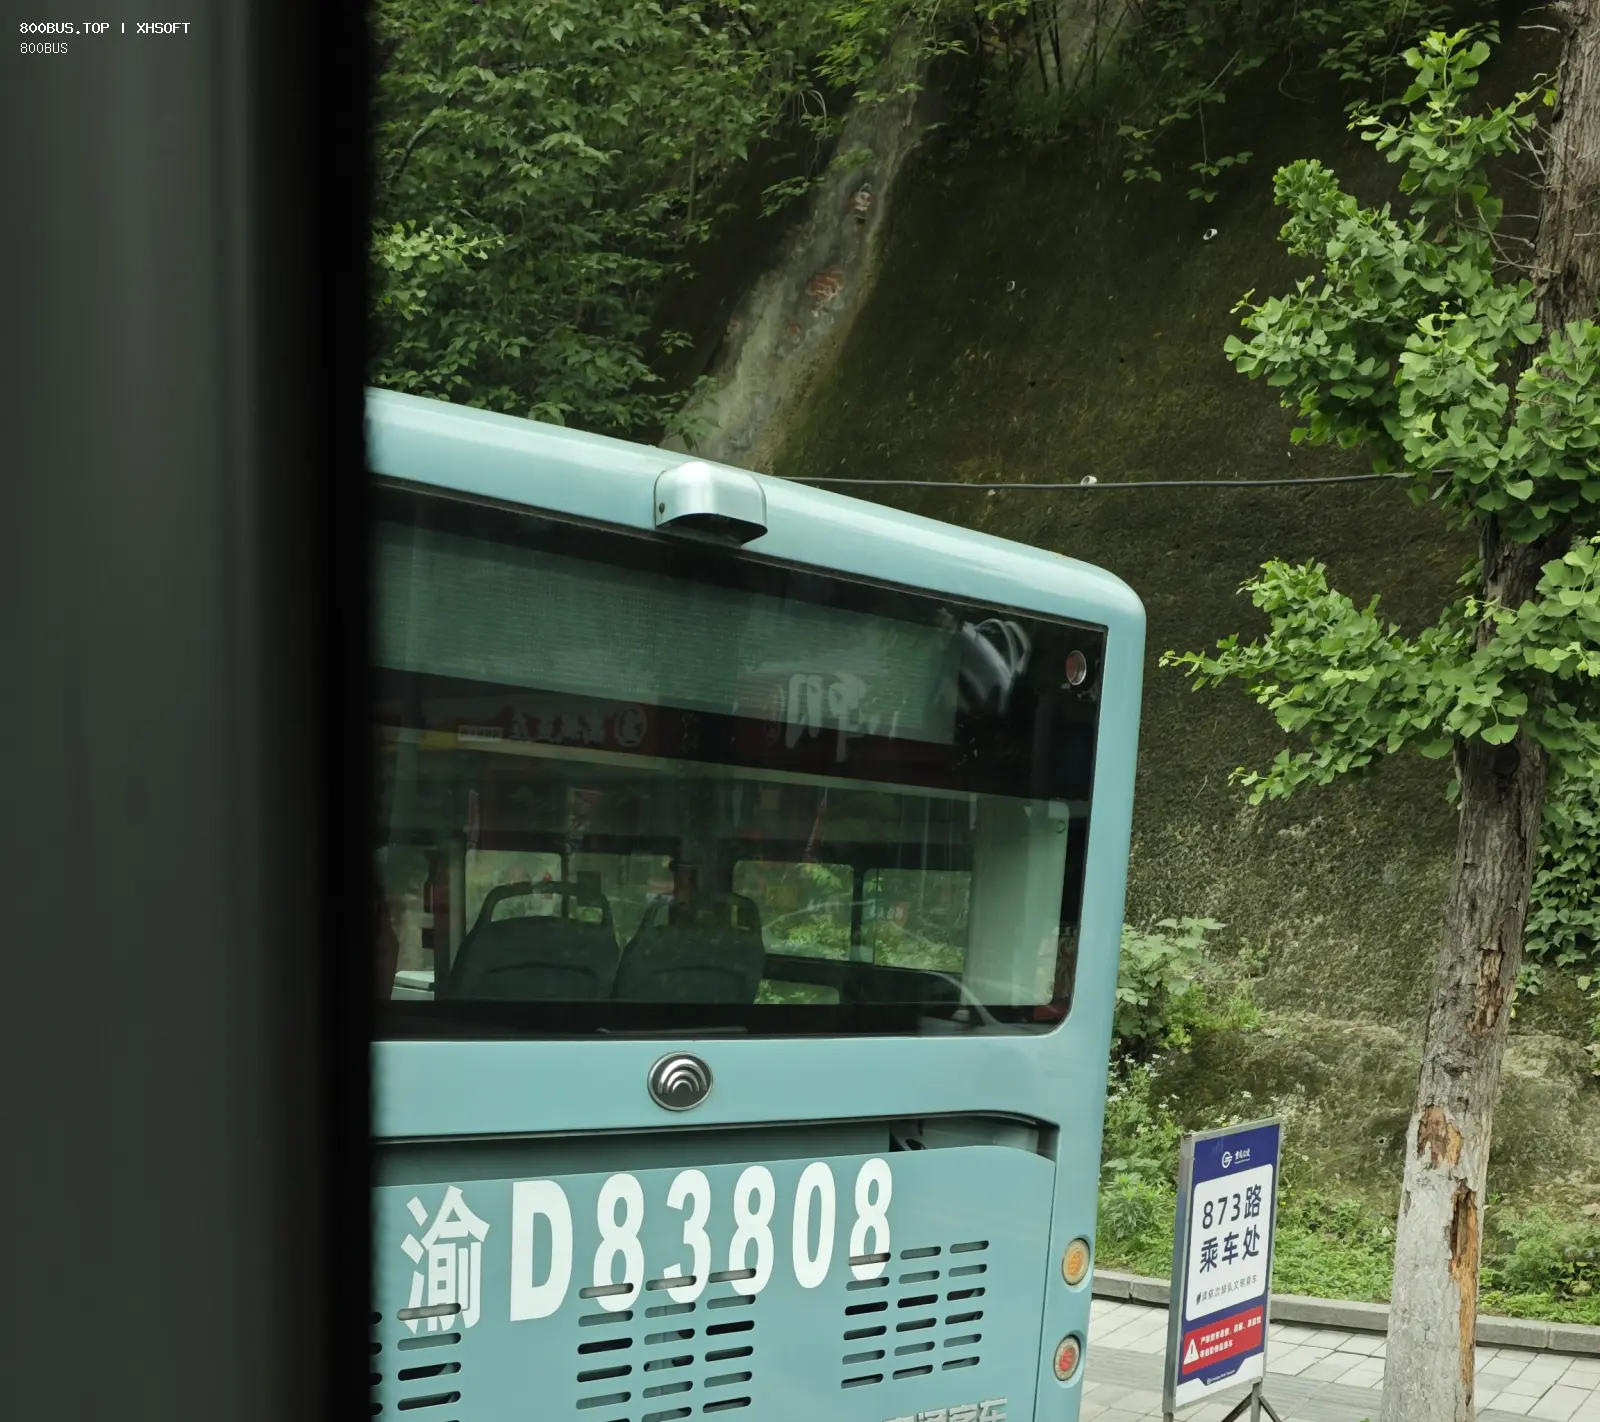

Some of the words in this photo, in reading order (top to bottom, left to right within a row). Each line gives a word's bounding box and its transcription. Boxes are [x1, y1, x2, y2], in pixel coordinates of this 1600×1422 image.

[1202, 1184, 1262, 1230] 873路
[1199, 1224, 1261, 1275] 乘车处
